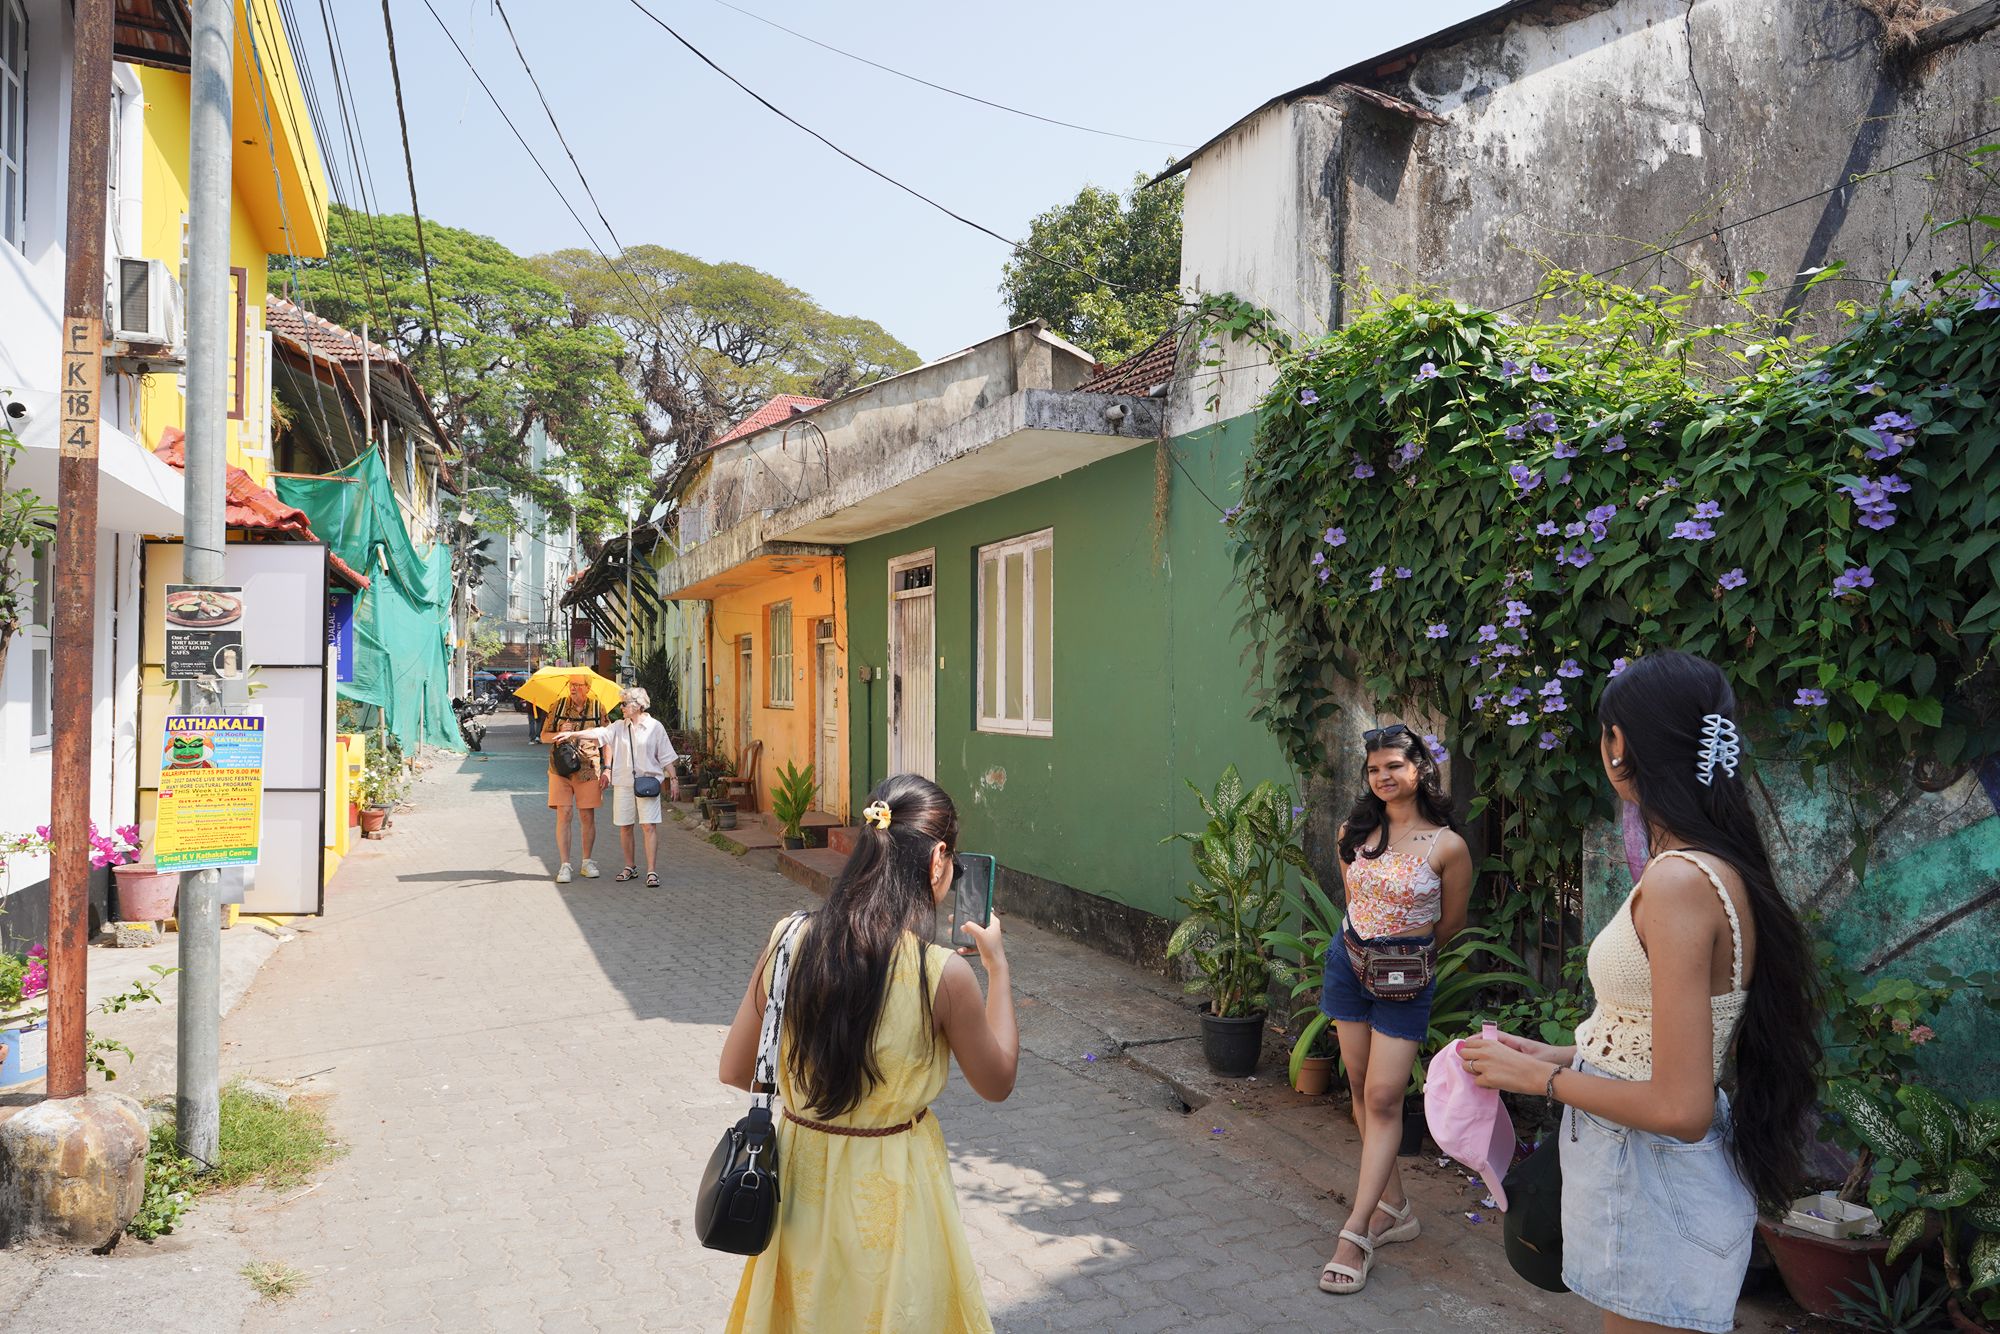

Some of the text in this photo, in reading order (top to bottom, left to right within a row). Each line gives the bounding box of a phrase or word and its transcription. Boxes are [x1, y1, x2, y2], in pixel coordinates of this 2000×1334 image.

[72, 326, 88, 350] F
[68, 362, 86, 386] K
[67, 394, 90, 416] 18
[68, 426, 92, 449] 4
[168, 718, 259, 730] KATHAKALI
